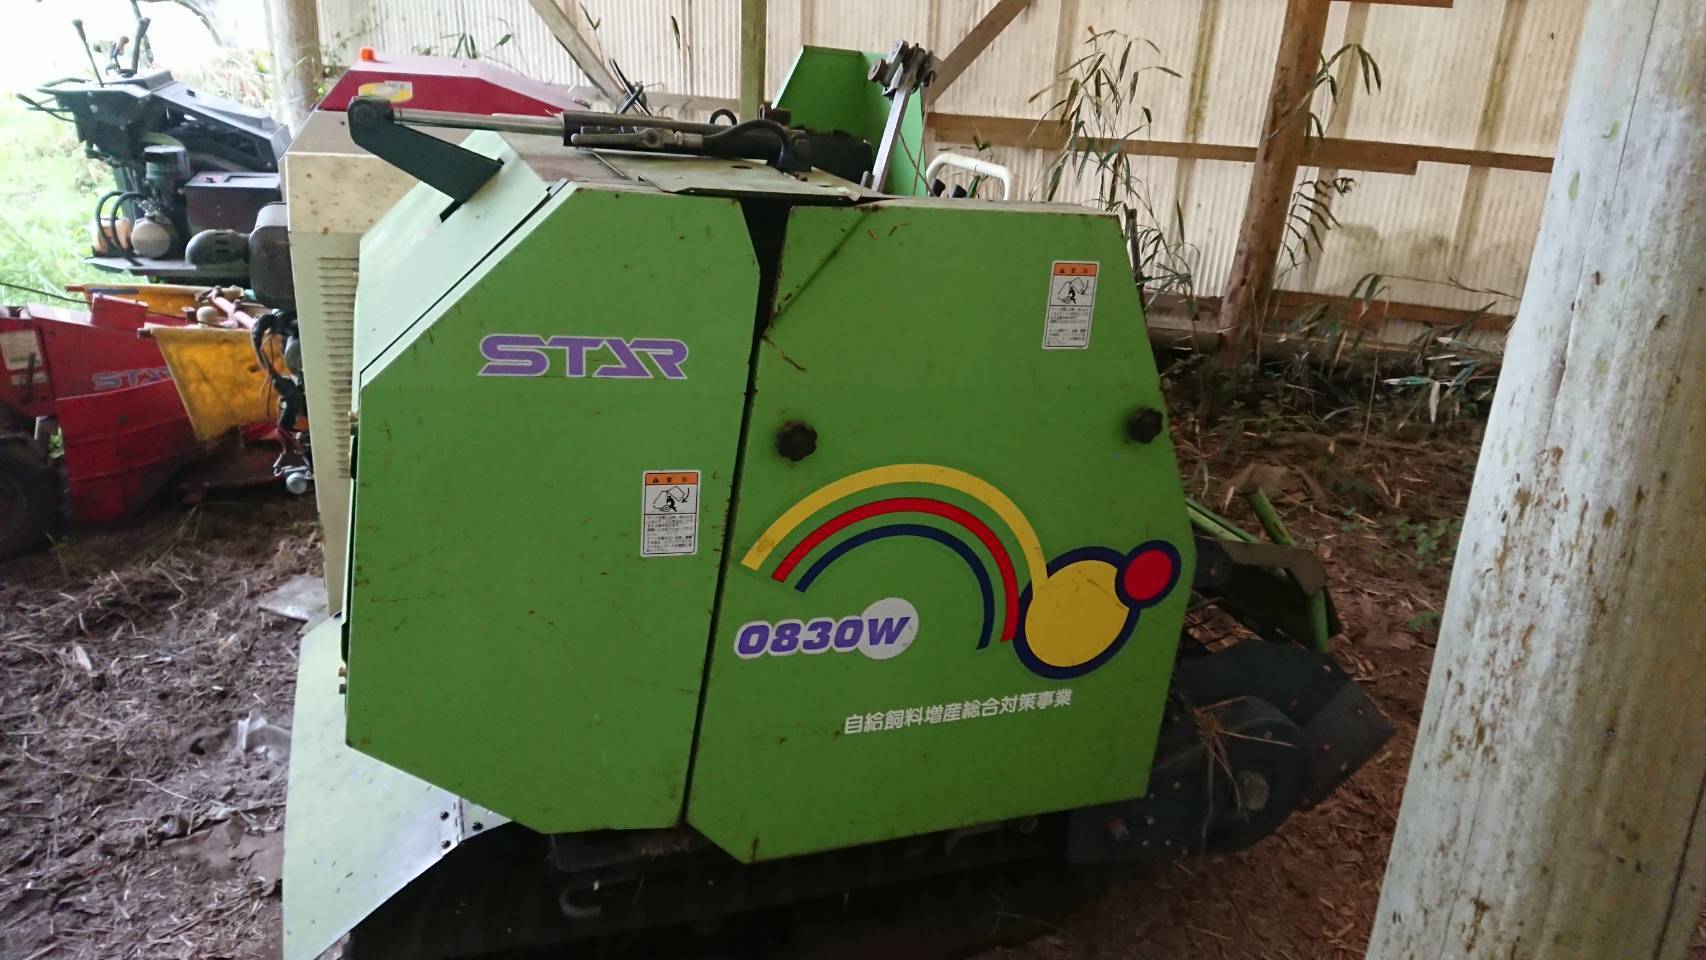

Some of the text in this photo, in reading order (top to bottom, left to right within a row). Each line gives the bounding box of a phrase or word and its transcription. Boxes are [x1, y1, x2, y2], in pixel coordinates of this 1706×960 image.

[478, 334, 688, 379] STAR
[735, 615, 911, 658] 0830W
[844, 688, 1073, 734] 自給飼料増産総合対策事業
